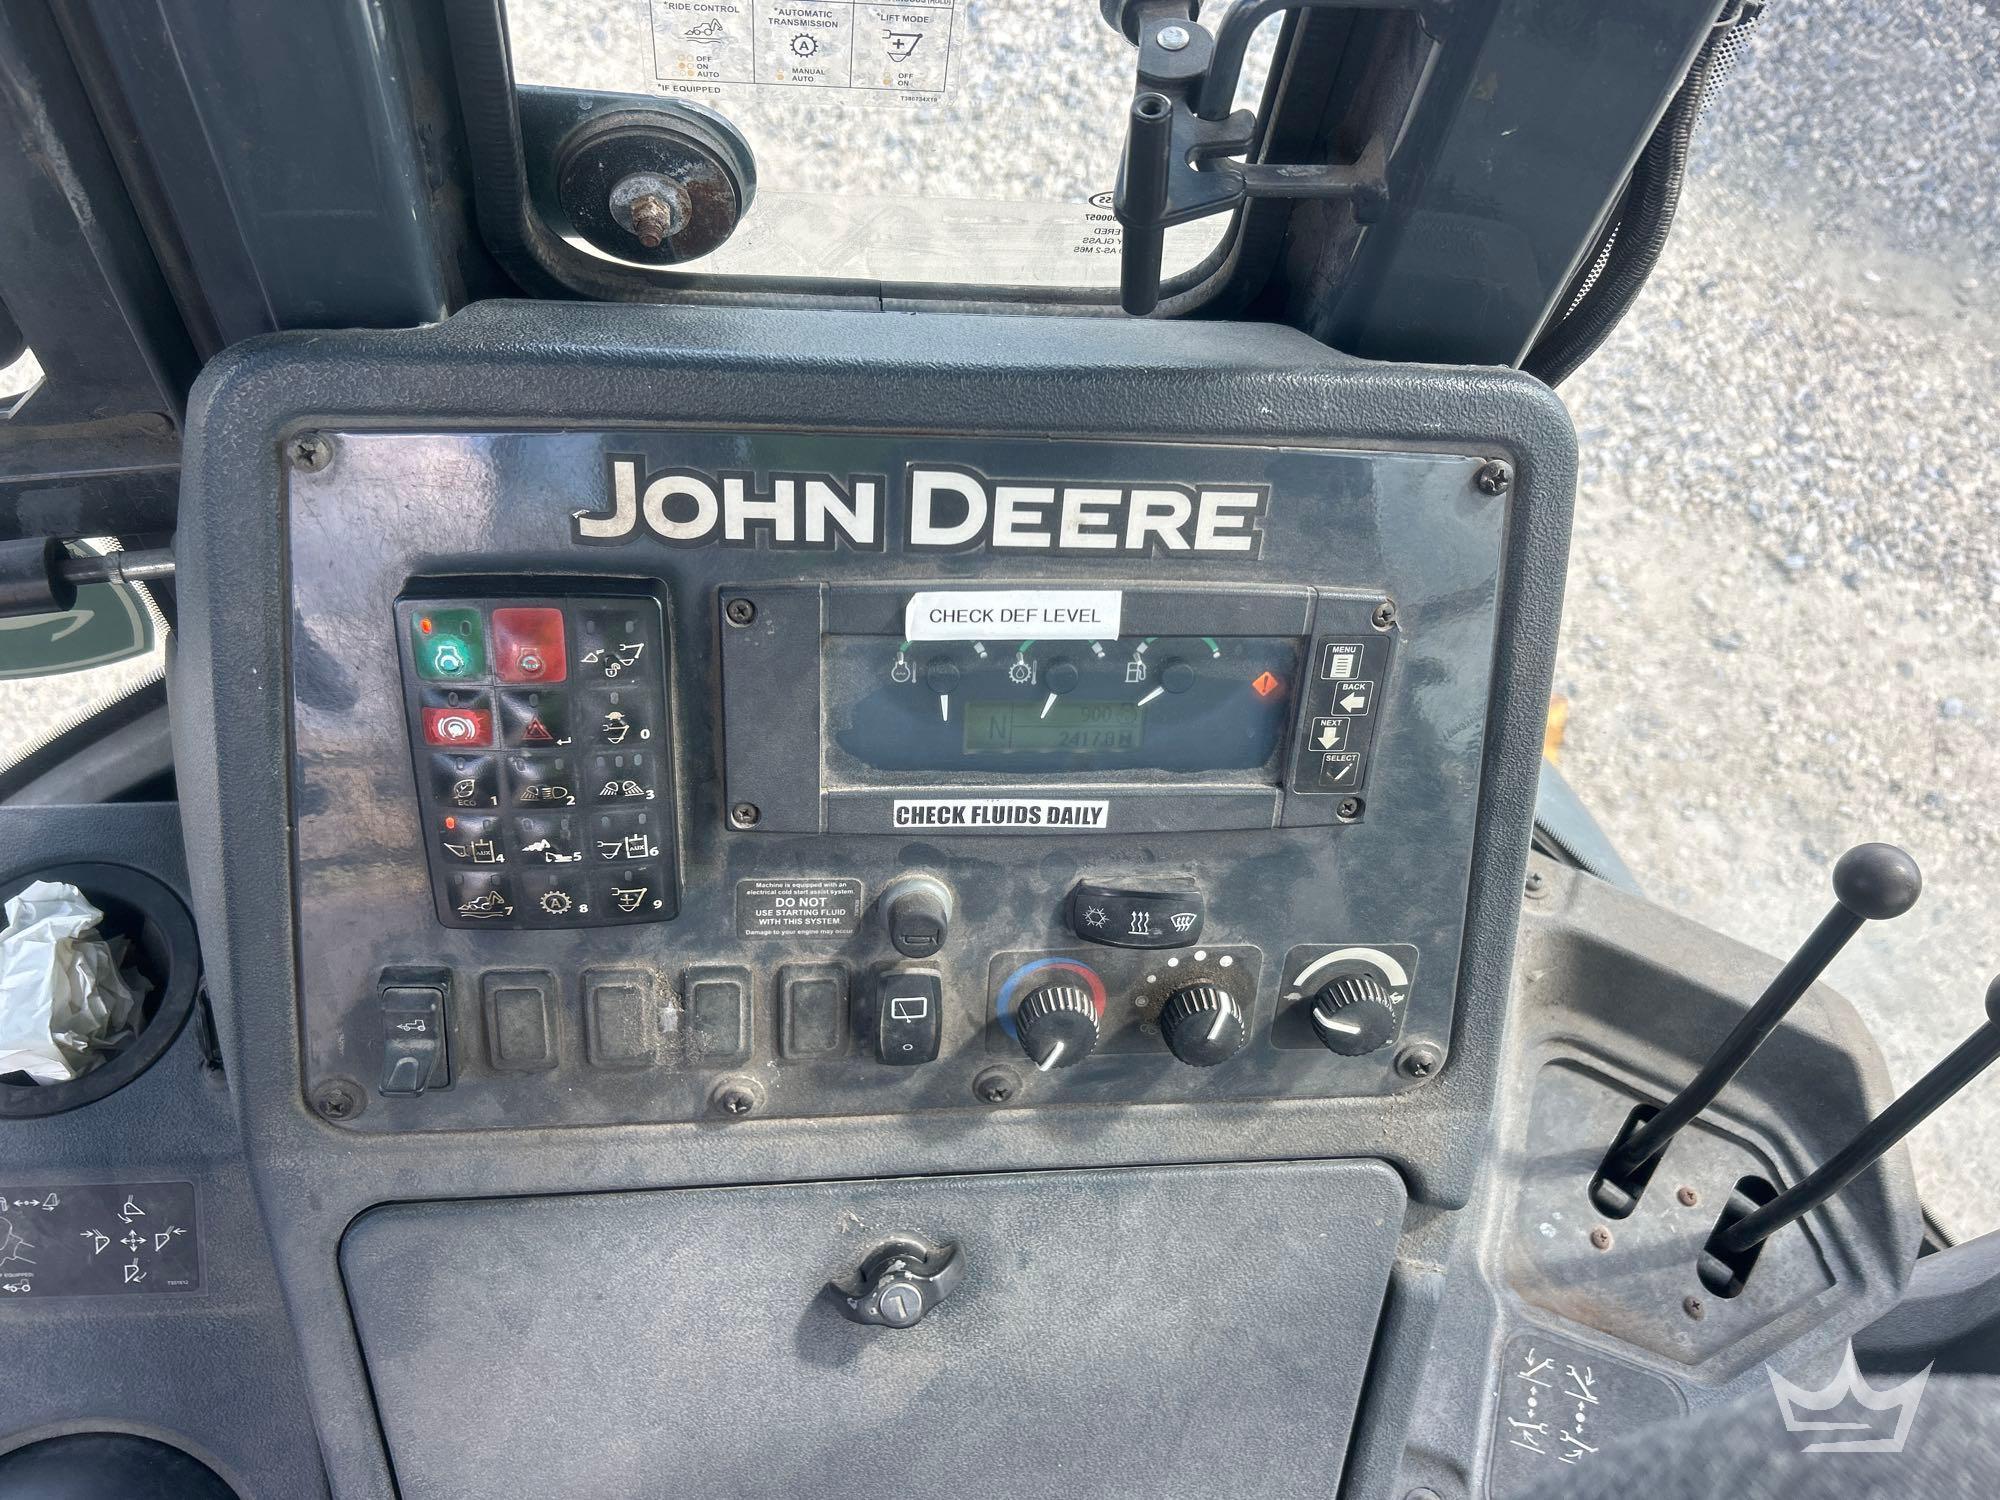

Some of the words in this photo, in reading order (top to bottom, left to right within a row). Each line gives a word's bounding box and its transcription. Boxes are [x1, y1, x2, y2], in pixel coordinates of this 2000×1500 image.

[694, 4, 740, 14] CONTROL
[768, 18, 838, 28] TRANSMISSION
[902, 15, 930, 24] MODE
[792, 68, 826, 76] MANUAL
[672, 85, 722, 94] EQUIPPED
[578, 461, 875, 544] JOHN
[911, 469, 1259, 551] DEERE
[929, 608, 994, 623] CHECK
[1000, 608, 1038, 622] DEF
[1044, 608, 1101, 622] LEVEL
[989, 715, 1006, 740] N
[646, 790, 655, 800] 3
[457, 799, 478, 807] ECO
[491, 796, 498, 806] 1
[566, 796, 576, 806] 2
[896, 806, 966, 824] CHECK
[970, 806, 1042, 824] FLUIDS
[1046, 806, 1102, 825] DAILY
[650, 846, 659, 857] 6
[496, 854, 505, 863] 4
[573, 852, 582, 862] 5
[654, 900, 663, 909] 9
[775, 897, 796, 908] DO
[799, 897, 828, 907] NOT
[505, 906, 514, 916] 7
[579, 904, 588, 914] 8
